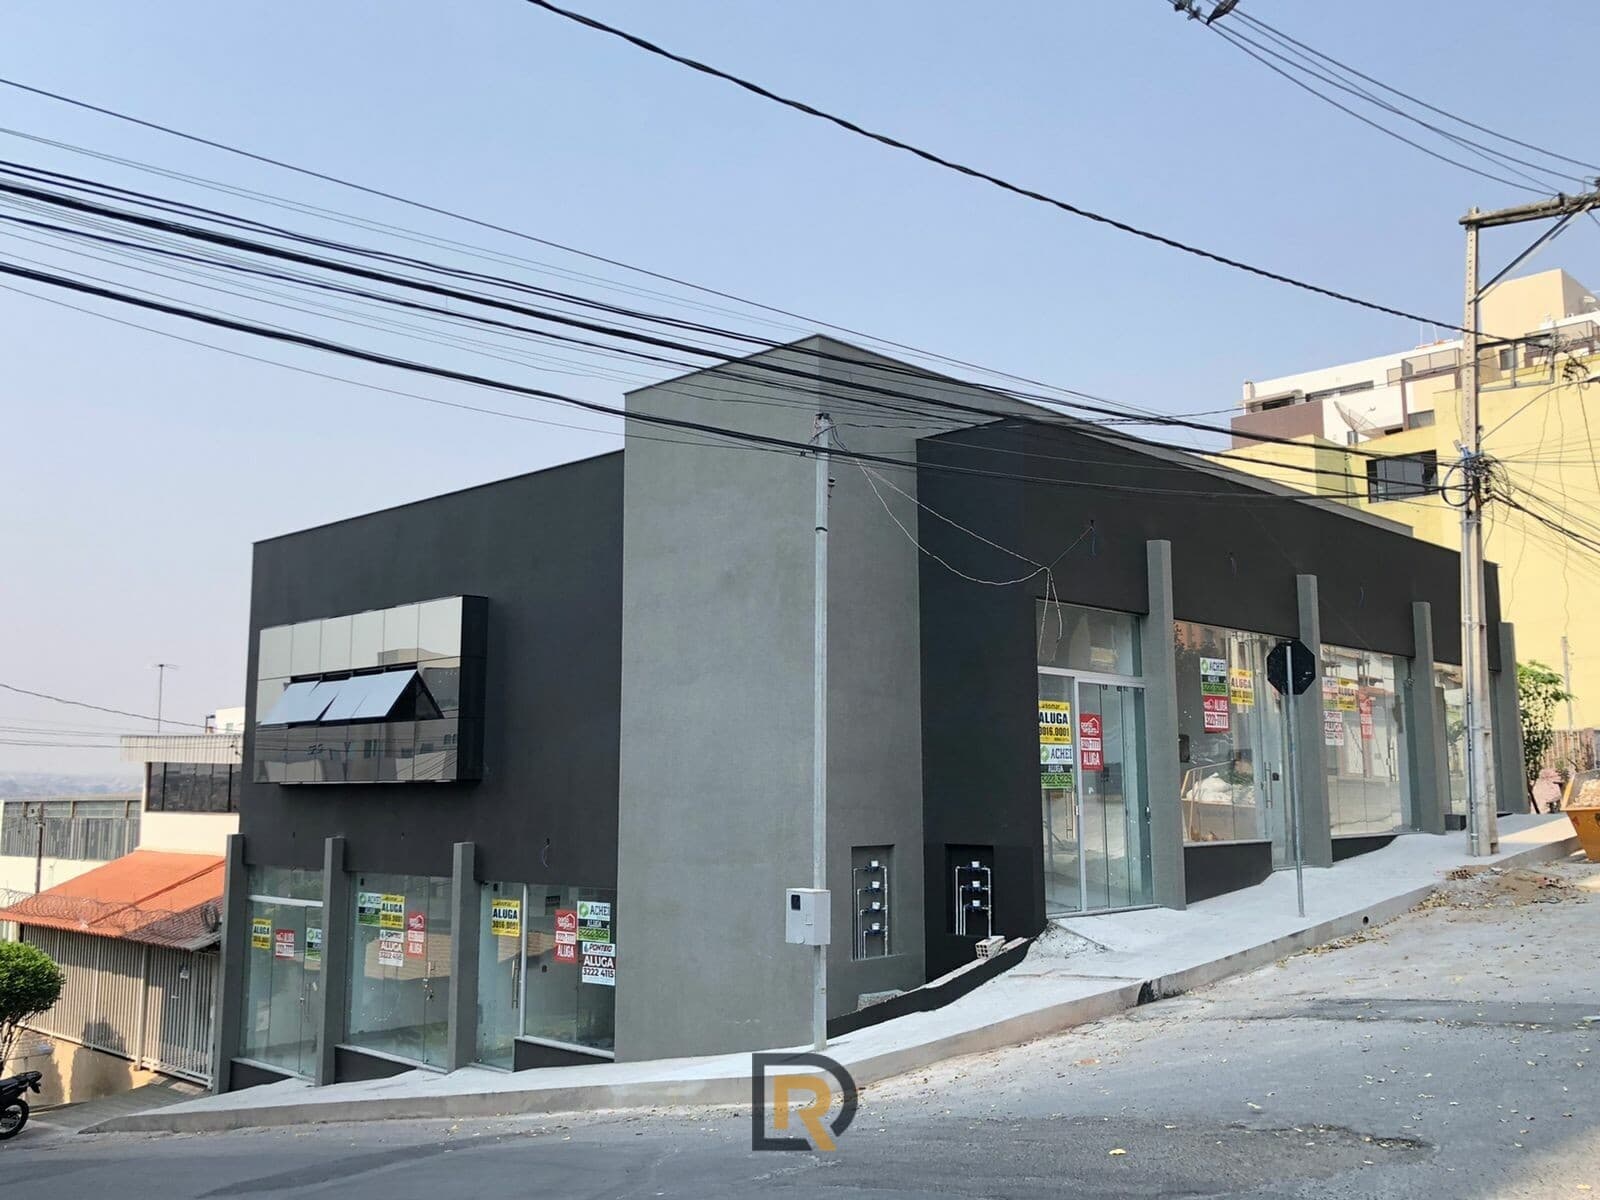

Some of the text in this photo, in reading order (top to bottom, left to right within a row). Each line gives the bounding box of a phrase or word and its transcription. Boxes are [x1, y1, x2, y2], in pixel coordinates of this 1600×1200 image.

[1039, 711, 1069, 725] ALUGA
[1051, 748, 1072, 760] ACHEI
[1083, 752, 1101, 766] ALUGA
[382, 902, 403, 913] ALUGA
[589, 904, 610, 916] ACHEI
[492, 908, 518, 920] ALUGA
[380, 941, 403, 952] ALUGA
[557, 943, 575, 958] ALUGA
[583, 955, 614, 969] ALUGA
[583, 967, 600, 977] 3222
